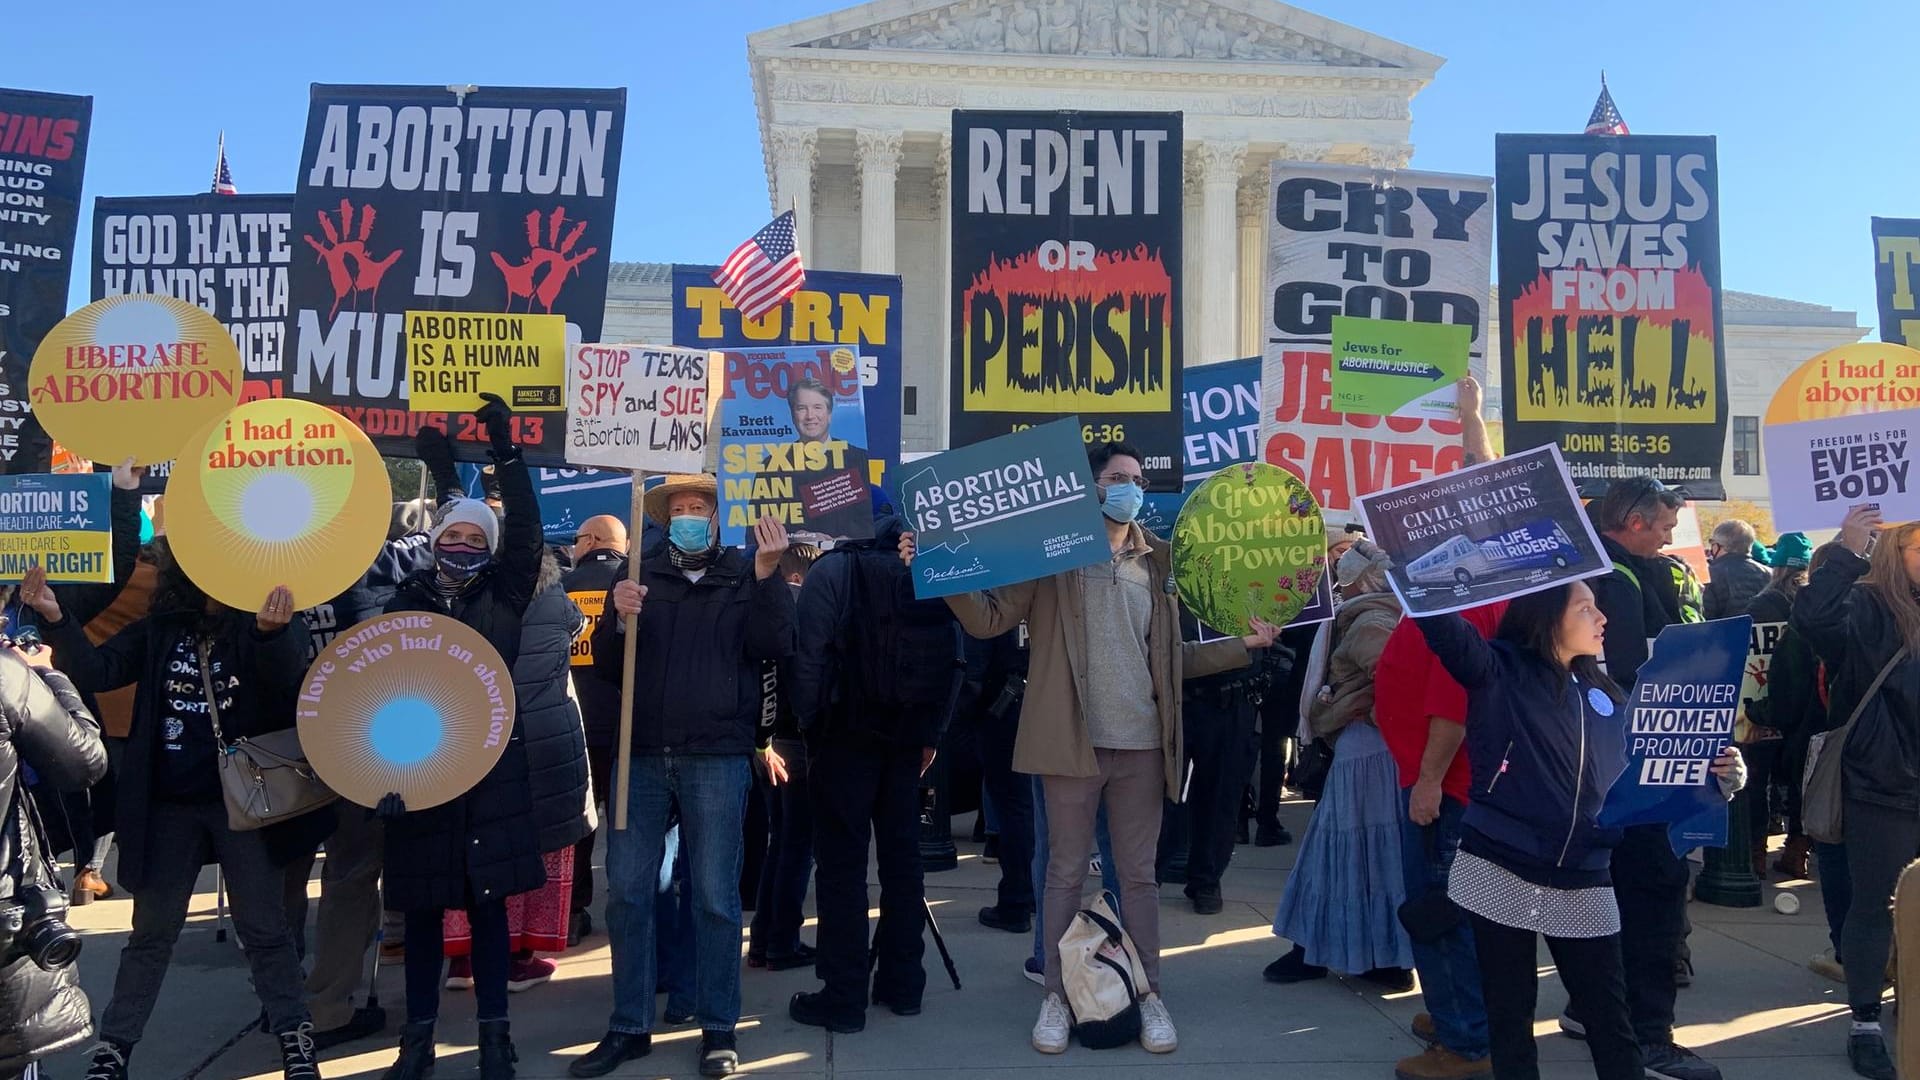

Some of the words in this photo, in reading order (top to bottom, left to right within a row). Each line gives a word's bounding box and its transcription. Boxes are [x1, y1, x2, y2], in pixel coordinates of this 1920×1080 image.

[309, 105, 613, 197] ABORTION
[968, 127, 1168, 216] REPENT
[1512, 152, 1710, 222] JESUS
[1276, 177, 1488, 241] CRY
[104, 214, 177, 265] GOD
[188, 213, 291, 264] HATE
[413, 210, 479, 297] IS
[1538, 221, 1688, 269] SAVES
[1037, 239, 1098, 273] OR
[1328, 242, 1431, 287] TO
[104, 267, 215, 318] HANDS
[1551, 270, 1675, 311] FROM
[686, 287, 890, 345] TURN
[1273, 281, 1480, 343] GOD
[411, 316, 523, 341] ABORTION
[65, 342, 209, 370] LIBERATE
[413, 344, 434, 366] IS
[442, 344, 457, 366] A
[464, 345, 539, 368] HUMAN
[969, 290, 1168, 398] PERISH
[1343, 341, 1378, 354] Jews
[1381, 343, 1403, 356] for
[578, 346, 630, 380] STOP
[642, 351, 703, 381] TEXAS
[723, 350, 858, 401] People
[1342, 356, 1390, 371] ABORTION
[1391, 361, 1429, 374] JUSTICE
[1526, 314, 1706, 410] HELL
[1822, 360, 1828, 378] i
[1839, 359, 1884, 378] had
[32, 369, 233, 403] ABORTION
[413, 371, 480, 393] RIGHT
[1805, 379, 1920, 402] abortio
[578, 381, 624, 416] SPY
[625, 390, 657, 413] and
[660, 385, 705, 417] SUE
[225, 419, 232, 440] i
[244, 418, 291, 440] had
[304, 423, 335, 439] an
[573, 421, 640, 448] abortion
[575, 417, 601, 426] anti-
[721, 425, 793, 438] Kavanaugh
[739, 415, 774, 426] Brett
[1562, 434, 1605, 452] JOHN
[1610, 434, 1671, 453] 3:16-36
[1810, 434, 1863, 448] FREEDOM
[1869, 431, 1880, 441] IS
[1886, 429, 1908, 440] FOR
[208, 442, 352, 469] abortion.
[722, 440, 848, 474] SEXIST
[1810, 440, 1908, 482] EVERY
[724, 476, 794, 502] MAN
[914, 457, 1044, 511] ABORTION
[1376, 495, 1417, 513] YOUNG
[1419, 481, 1465, 500] WOMEN
[1468, 473, 1490, 486] FOR
[1494, 460, 1545, 481] AMERICA
[1814, 459, 1910, 502] BODY
[70, 490, 88, 512] IS
[917, 510, 942, 532] IS
[947, 471, 1086, 524] ESSENTIAL
[1210, 482, 1295, 518] Grow
[1402, 505, 1457, 530] CIVIL
[1458, 482, 1532, 513] RIGHTS
[36, 514, 62, 529] CARE
[727, 503, 804, 527] ALIVE
[1178, 510, 1319, 545] Abortion
[1407, 521, 1447, 543] BEGIN
[1449, 516, 1464, 531] IN
[1464, 508, 1494, 526] THE
[1496, 497, 1538, 518] WOMB
[30, 536, 56, 551] CARE
[60, 536, 70, 550] IS
[1043, 534, 1070, 546] CENTER
[1045, 534, 1095, 552] REPRODUCTIVE
[1500, 527, 1533, 547] LIFE
[1506, 535, 1560, 558] RIDERS
[46, 552, 104, 574] RIGHT
[1046, 547, 1070, 558] RIGHTS
[1214, 543, 1321, 572] Power
[301, 660, 336, 703] love
[335, 614, 433, 658] someone
[347, 643, 392, 674] who
[400, 634, 442, 651] had
[448, 643, 473, 664] an
[473, 663, 510, 749] abortion.
[1640, 684, 1736, 704] EMPOWER
[1636, 709, 1734, 732] WOMEN
[1631, 737, 1728, 757] PROMOTE
[1646, 760, 1703, 784] LIFE
